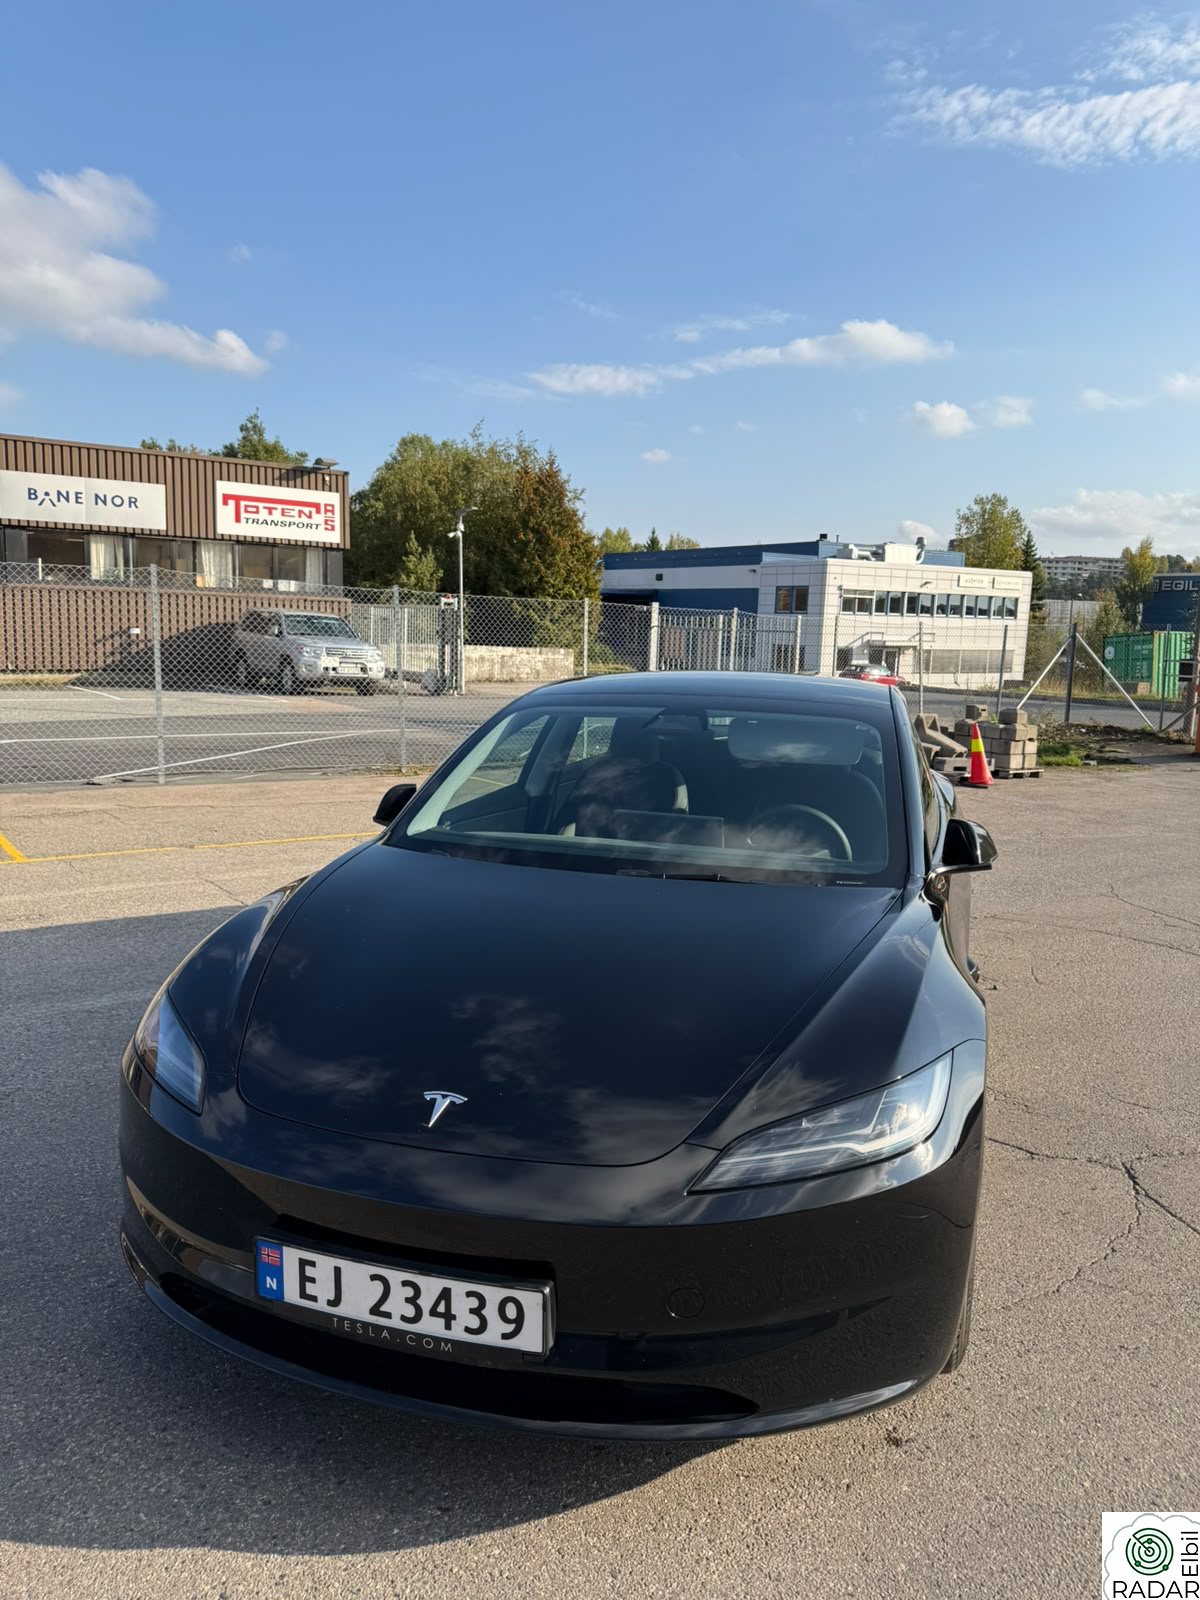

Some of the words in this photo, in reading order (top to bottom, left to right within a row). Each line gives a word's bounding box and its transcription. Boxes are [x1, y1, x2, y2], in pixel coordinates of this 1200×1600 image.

[27, 487, 84, 507] BANE
[94, 493, 139, 509] NOR
[222, 493, 322, 523] TOTEN
[244, 517, 322, 530] TRANSPORT
[1161, 580, 1199, 591] EGIL
[265, 1276, 277, 1290] N
[298, 1257, 342, 1308] EJ
[368, 1274, 525, 1340] 23439
[331, 1317, 454, 1353] TESLA.COM
